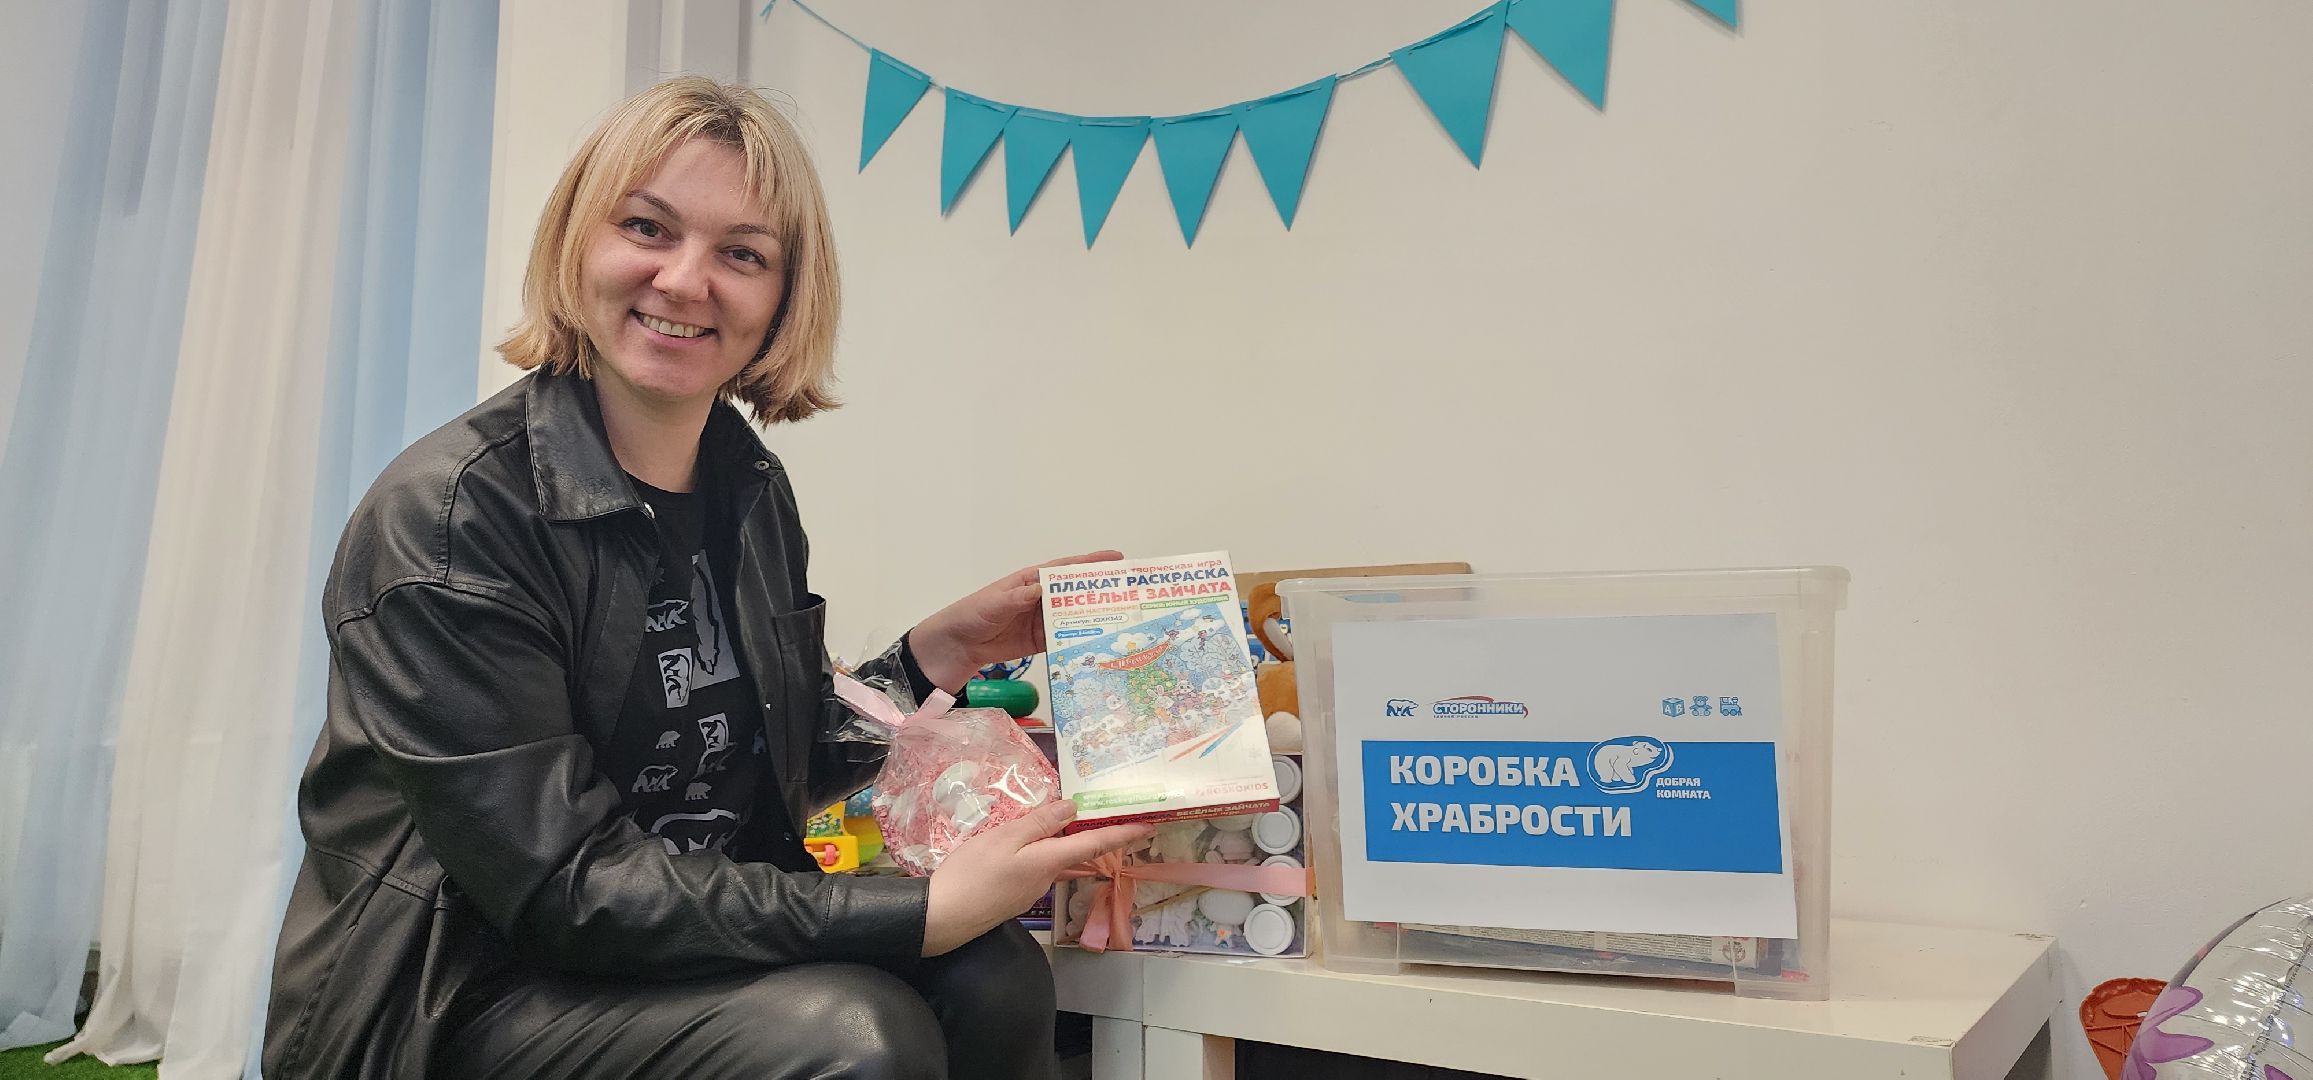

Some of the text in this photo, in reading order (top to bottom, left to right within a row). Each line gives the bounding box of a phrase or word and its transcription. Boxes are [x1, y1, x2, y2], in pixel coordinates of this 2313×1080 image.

[1048, 559, 1222, 581] Развивающая творческая игра
[1049, 567, 1230, 594] ПЛАКАТ РАСКРАСКА
[1050, 590, 1140, 609] ВЕСЁЛЫЕ
[1146, 581, 1232, 600] ЗАЙЧАТА
[1433, 703, 1524, 715] СТОРОННИКИ
[1390, 755, 1580, 787] КОРОБКА
[1655, 777, 1701, 788] ДОБРАЯ
[1656, 789, 1712, 800] КОМНАТА
[1391, 802, 1632, 837] ХРАБРОСТИ
